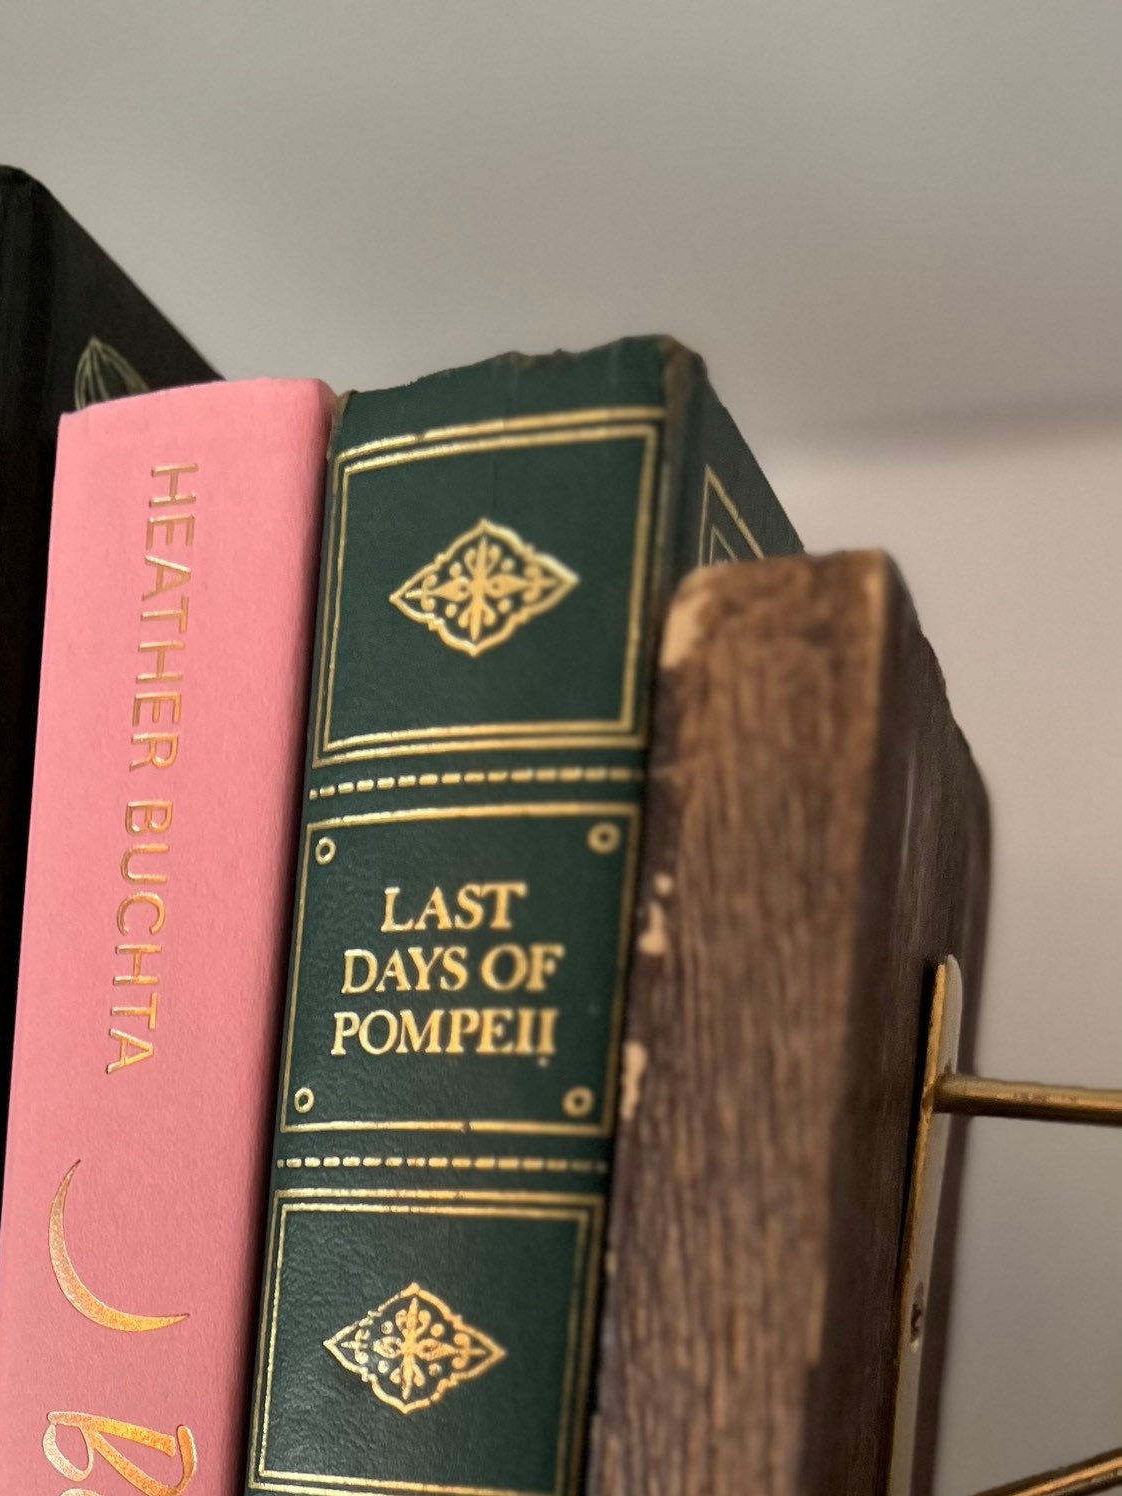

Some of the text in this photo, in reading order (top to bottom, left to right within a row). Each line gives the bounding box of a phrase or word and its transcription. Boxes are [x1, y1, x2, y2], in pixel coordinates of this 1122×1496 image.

[106, 463, 199, 1074] HEATHER BUCHTA
[381, 882, 528, 932] LAST
[341, 943, 566, 993] DAYS OF
[330, 1008, 560, 1056] POMPEII
